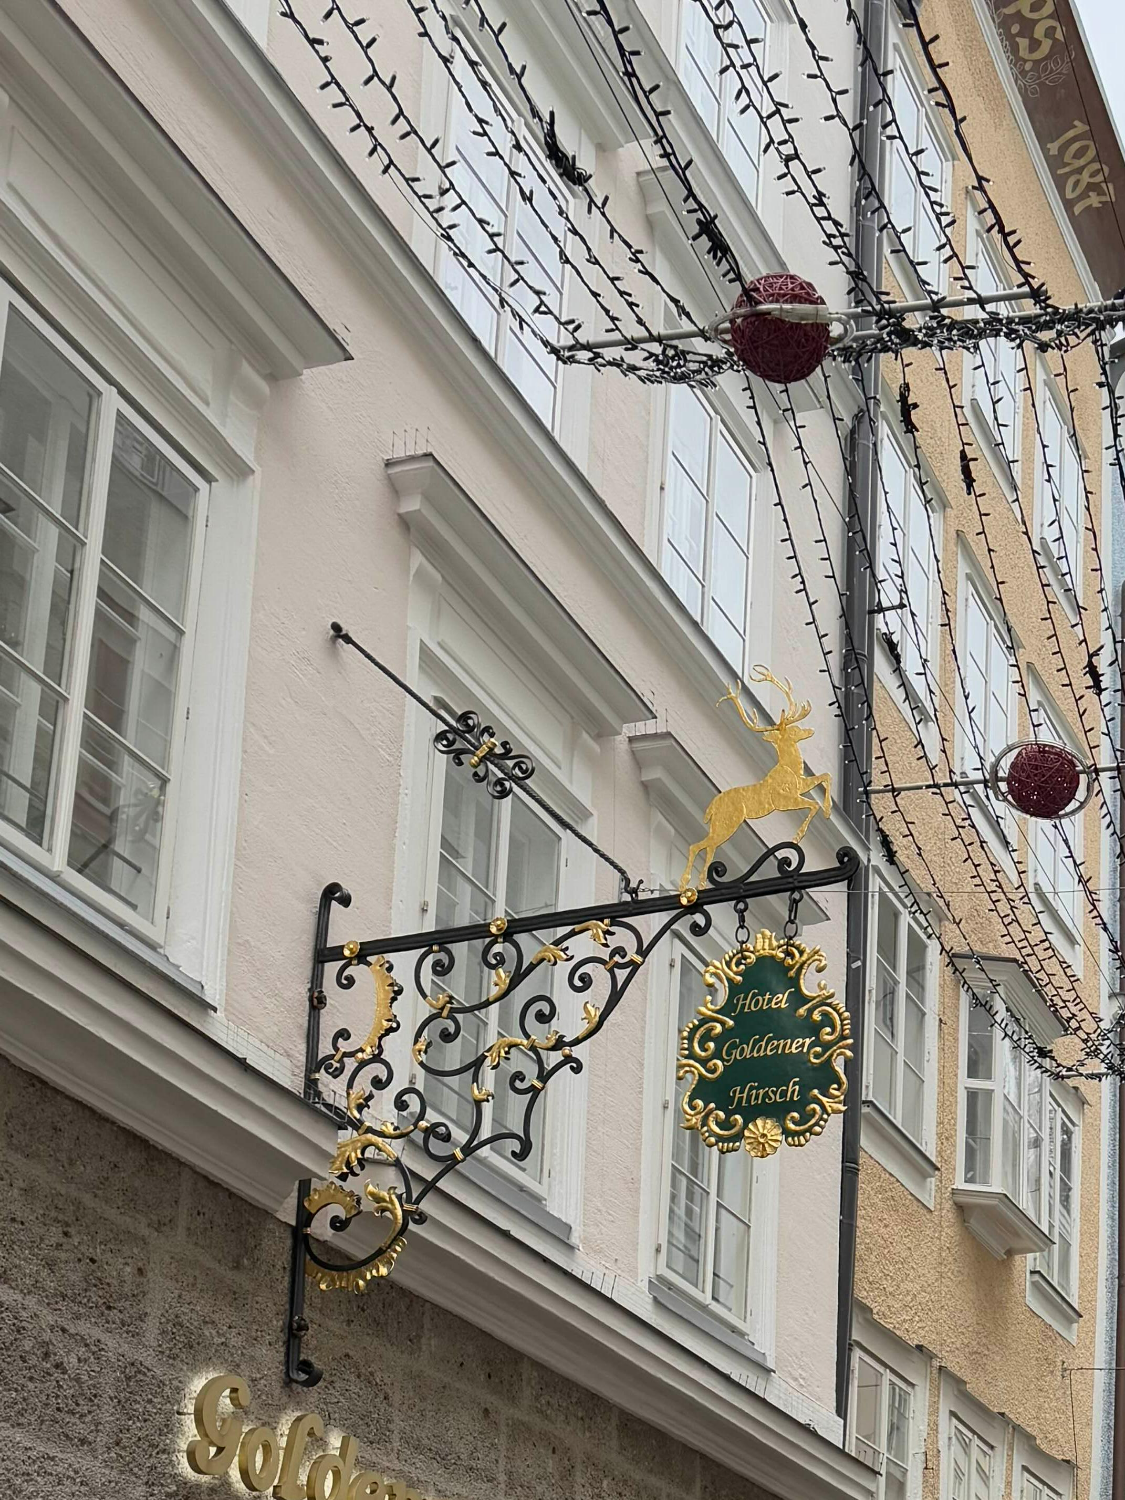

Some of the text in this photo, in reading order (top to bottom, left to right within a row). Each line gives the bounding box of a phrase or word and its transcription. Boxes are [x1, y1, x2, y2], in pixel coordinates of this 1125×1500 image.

[1047, 120, 1115, 216] 1987
[731, 987, 795, 1016] Hotel
[721, 1033, 815, 1066] Goldener
[728, 1077, 801, 1110] Hirsch
